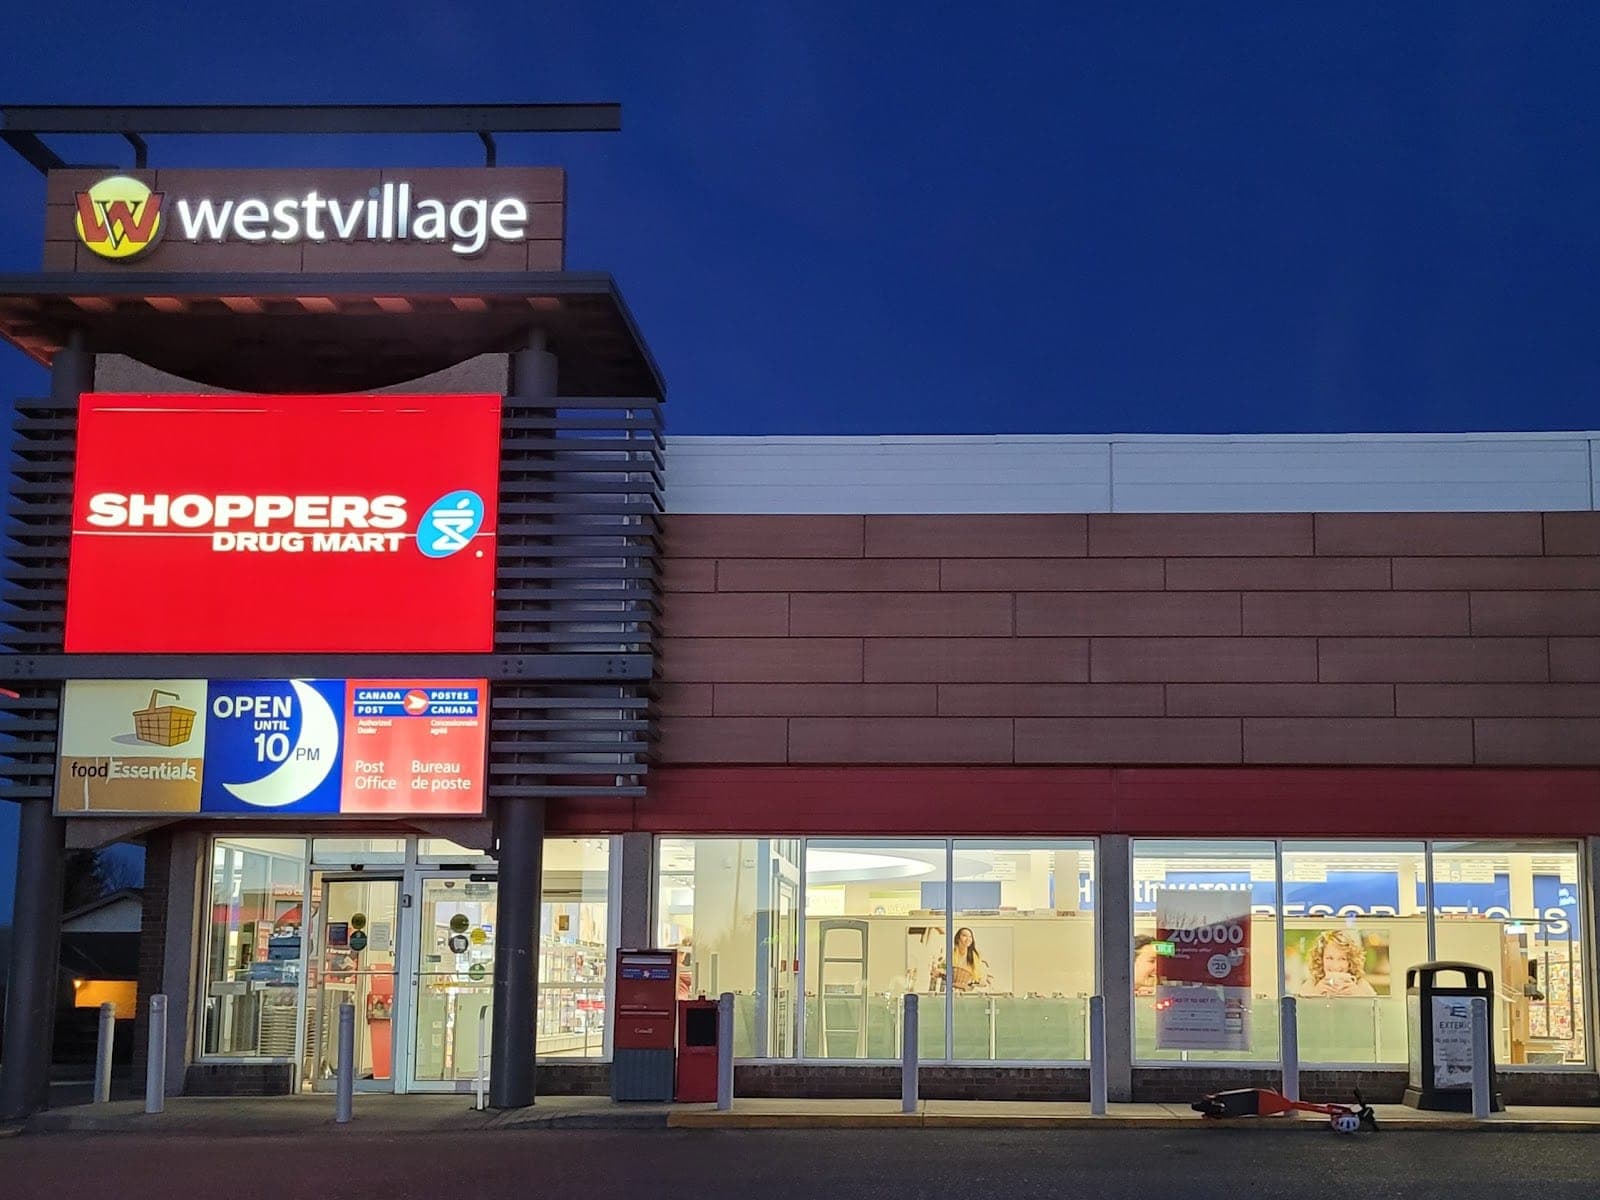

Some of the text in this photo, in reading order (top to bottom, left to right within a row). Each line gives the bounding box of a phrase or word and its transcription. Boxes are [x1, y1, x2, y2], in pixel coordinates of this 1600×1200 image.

[177, 183, 528, 254] westvillage
[87, 493, 408, 529] SHOPPERS
[212, 532, 406, 553] DRUG MART
[358, 691, 401, 700] CANADA
[431, 691, 469, 700] POSTES
[213, 696, 292, 718] OPEN
[358, 706, 384, 714] POST
[431, 706, 473, 714] CANADA
[254, 720, 290, 731] UNTIL
[254, 733, 320, 763] 10 PM
[71, 760, 198, 781] food Essentials
[355, 760, 385, 773] Post
[411, 760, 461, 774] Bureau
[355, 776, 397, 790] Office
[411, 776, 472, 793] de poste
